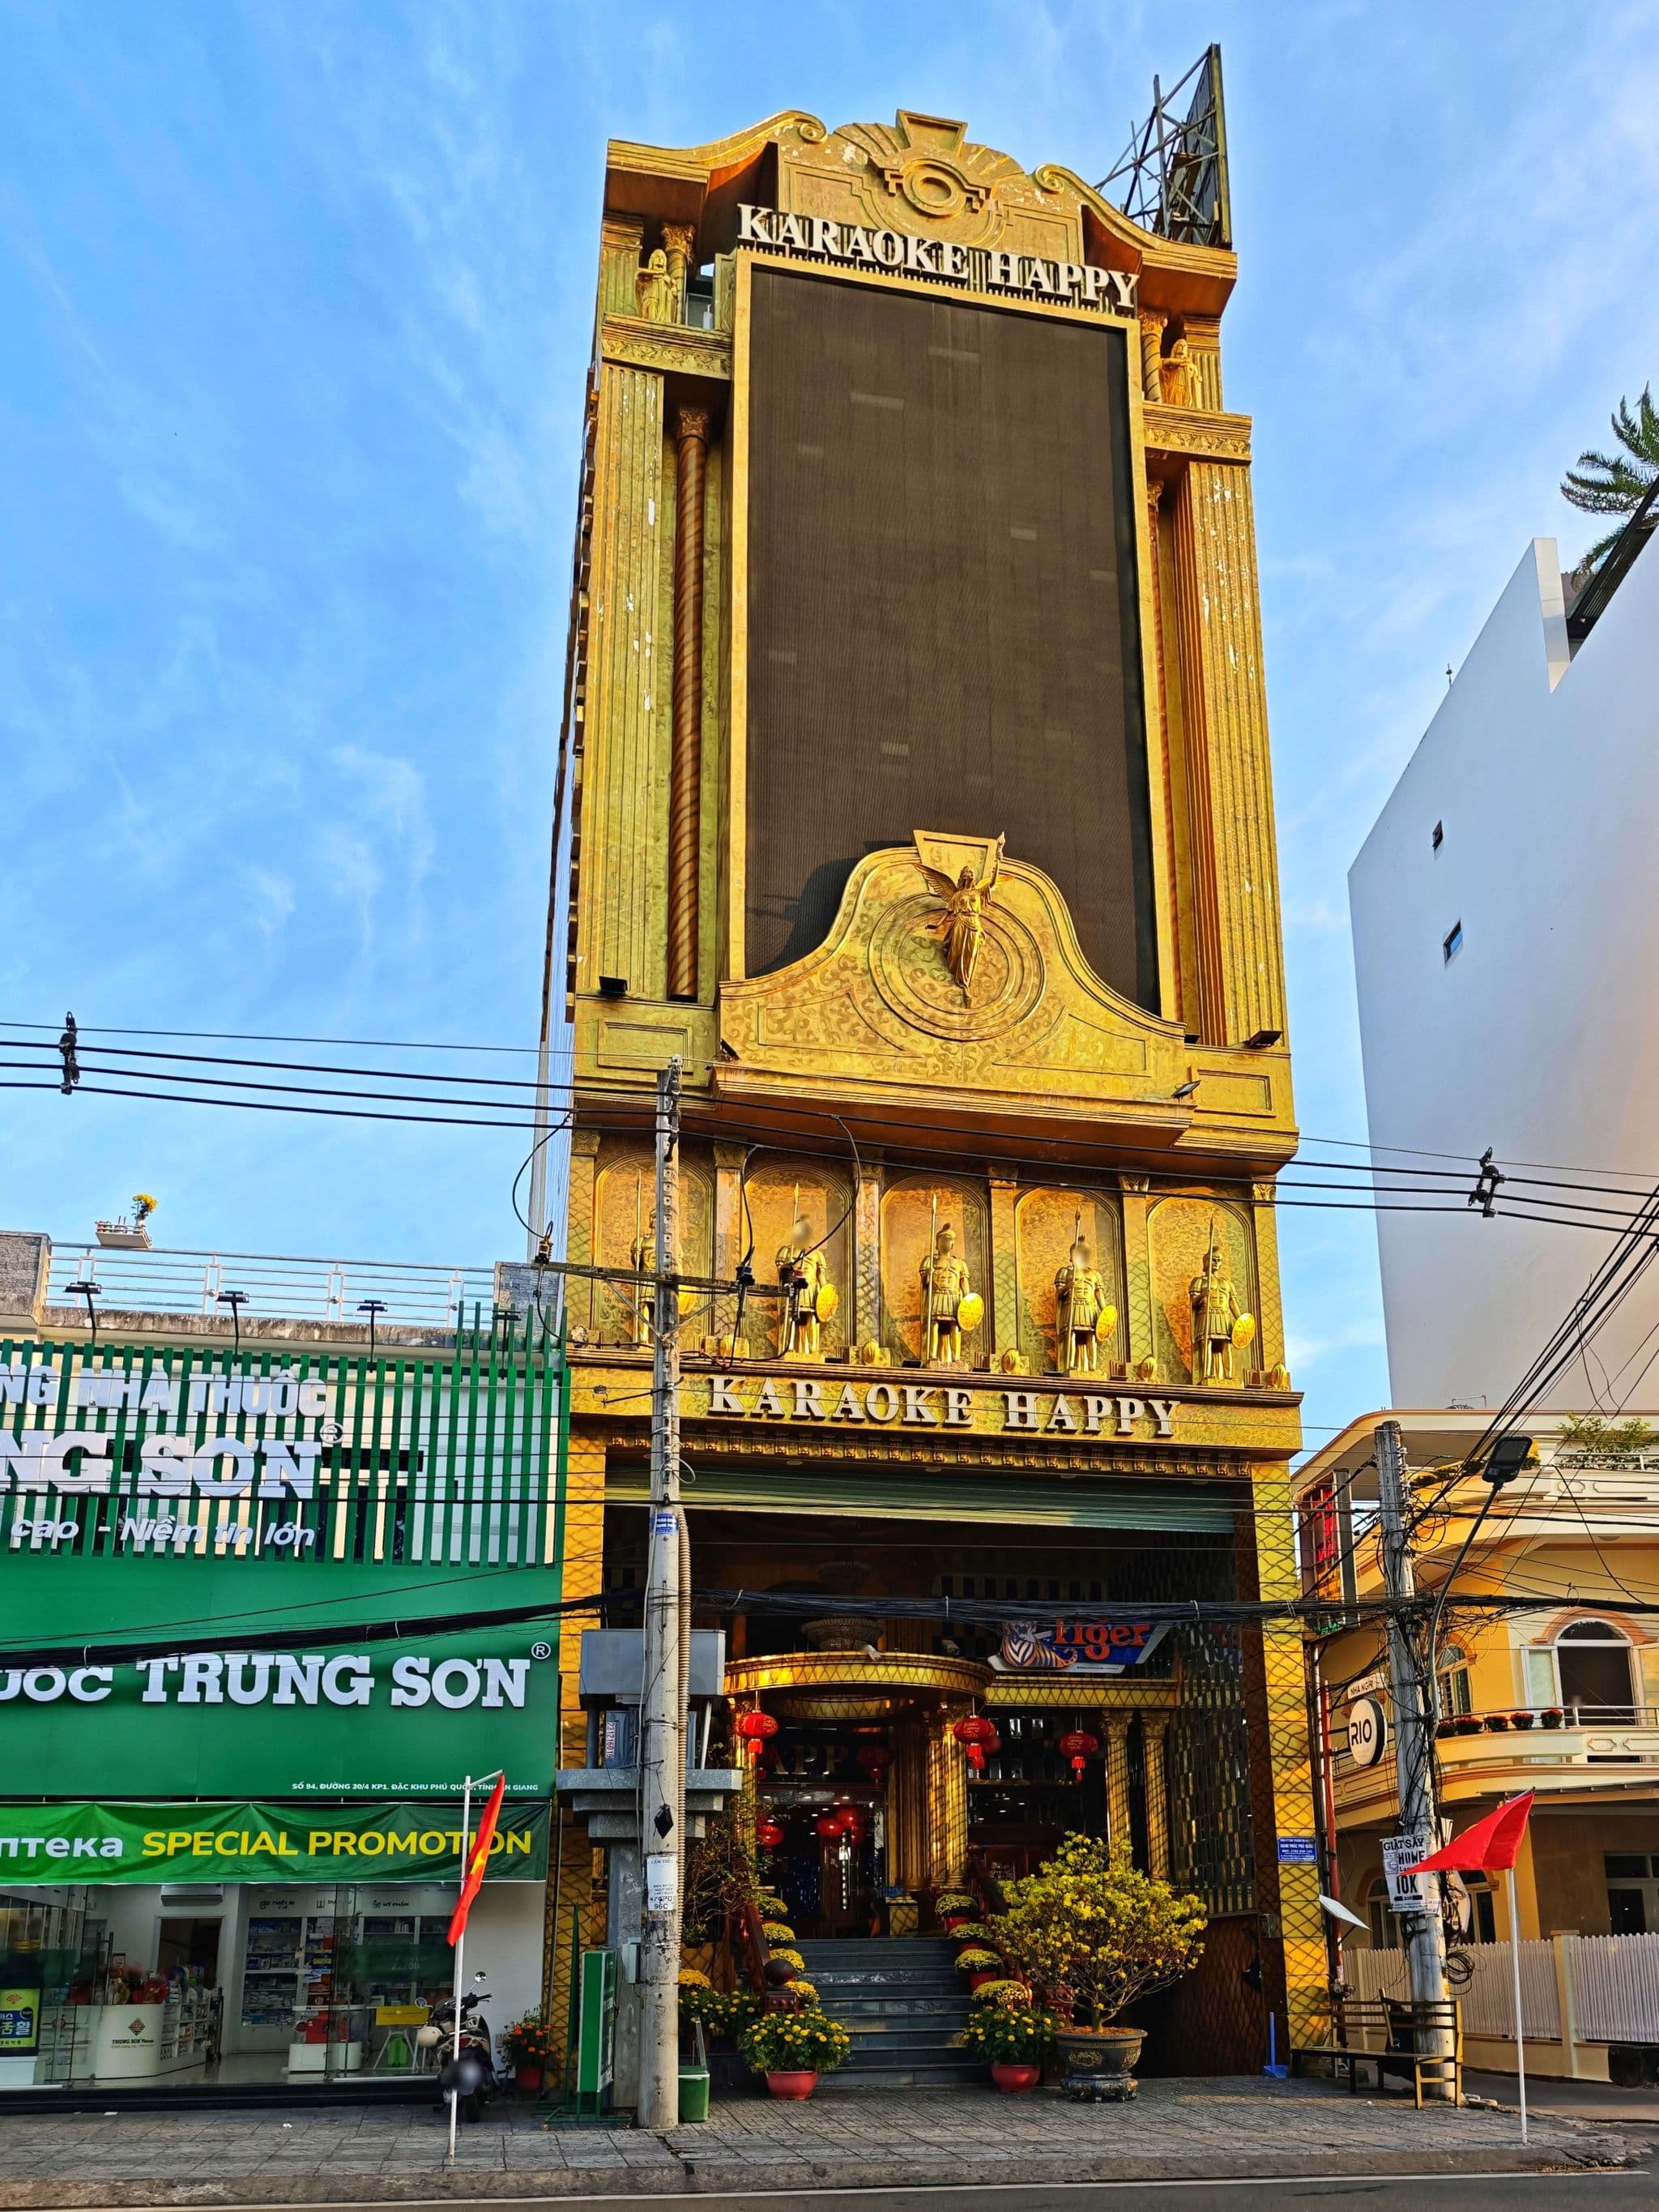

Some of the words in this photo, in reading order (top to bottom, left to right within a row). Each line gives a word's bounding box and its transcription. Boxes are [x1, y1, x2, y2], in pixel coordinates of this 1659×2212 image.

[738, 203, 970, 280] KARAOKE
[988, 251, 1140, 309] HAPPY
[189, 1364, 327, 1417] THUỐC
[708, 1374, 973, 1427] KARAOKE
[1003, 1390, 1181, 1437] HAPPY
[11, 1518, 79, 1539] cao
[120, 1515, 204, 1543] Niềm
[214, 1521, 254, 1545] tin
[263, 1522, 316, 1547] lớn
[136, 1652, 375, 1706] TRUNG
[390, 1655, 531, 1710] SƠN
[1350, 1719, 1372, 1746] RIO
[142, 1830, 299, 1857] SPECIAL
[308, 1830, 531, 1855] PROMOTION
[1398, 1850, 1426, 1865] HOME
